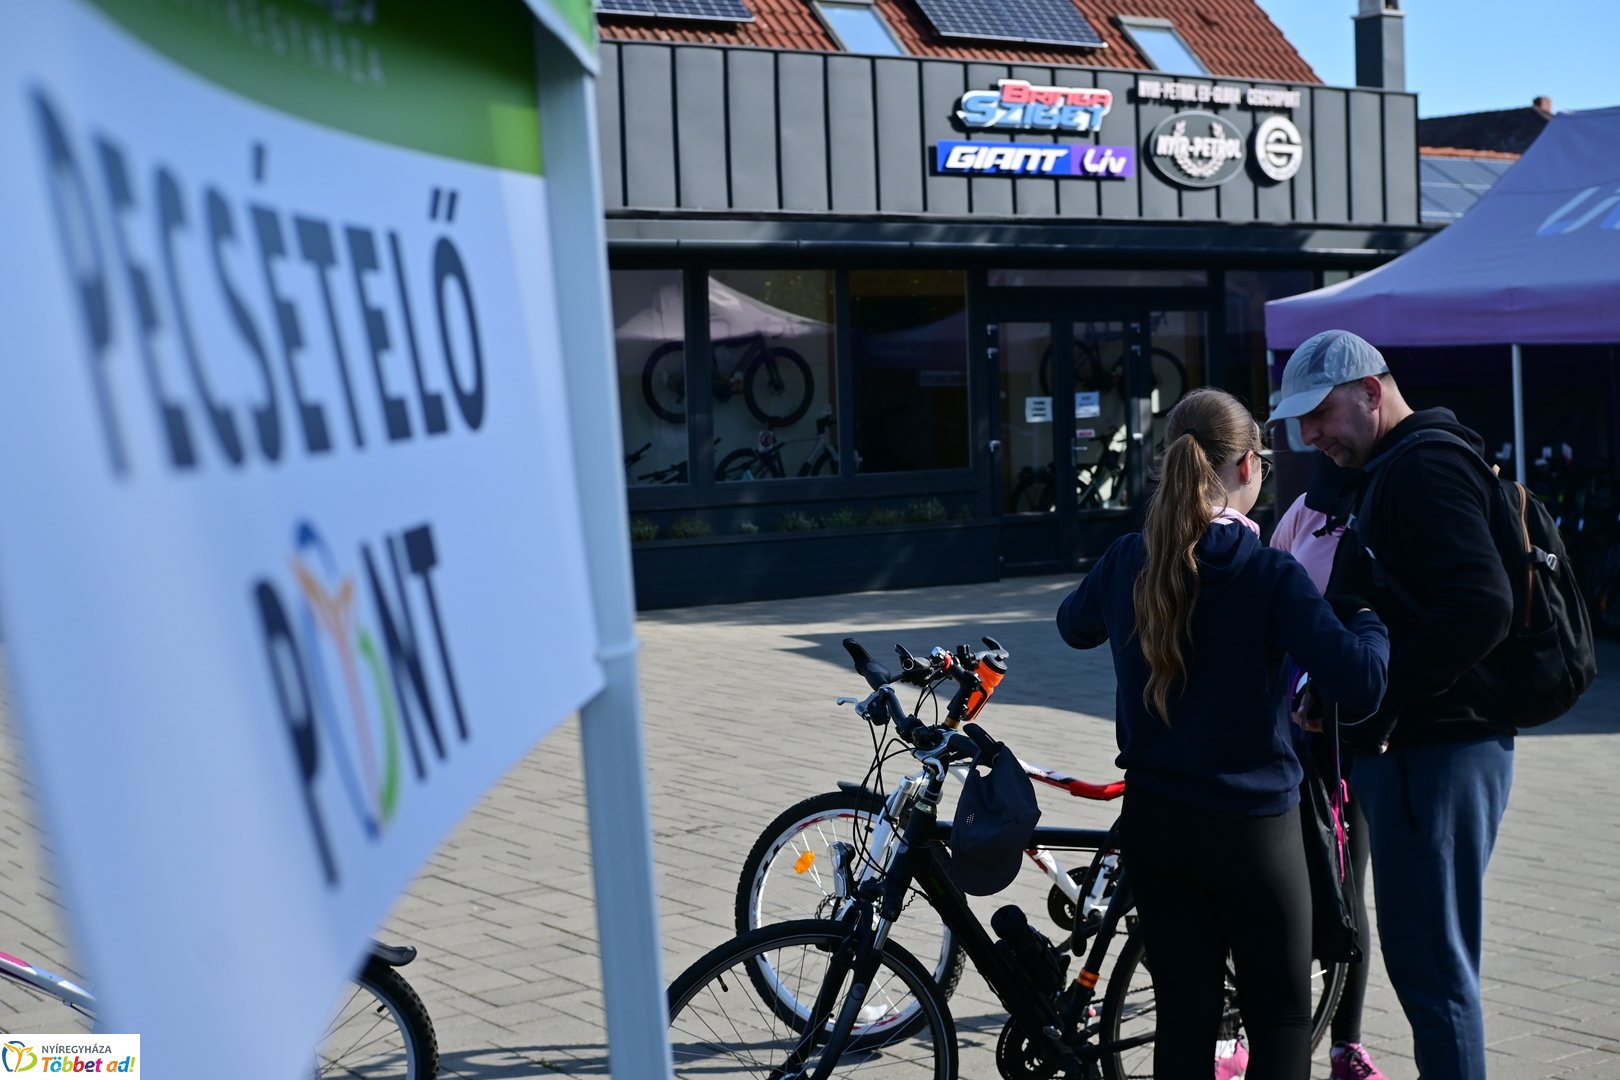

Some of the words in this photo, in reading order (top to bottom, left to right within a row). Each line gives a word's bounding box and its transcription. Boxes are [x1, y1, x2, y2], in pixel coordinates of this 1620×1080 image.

[962, 94, 1105, 130] SZIGET
[945, 145, 1069, 171] GIANT
[1083, 148, 1127, 174] Liv
[25, 78, 486, 484] PECSÉTELŐ
